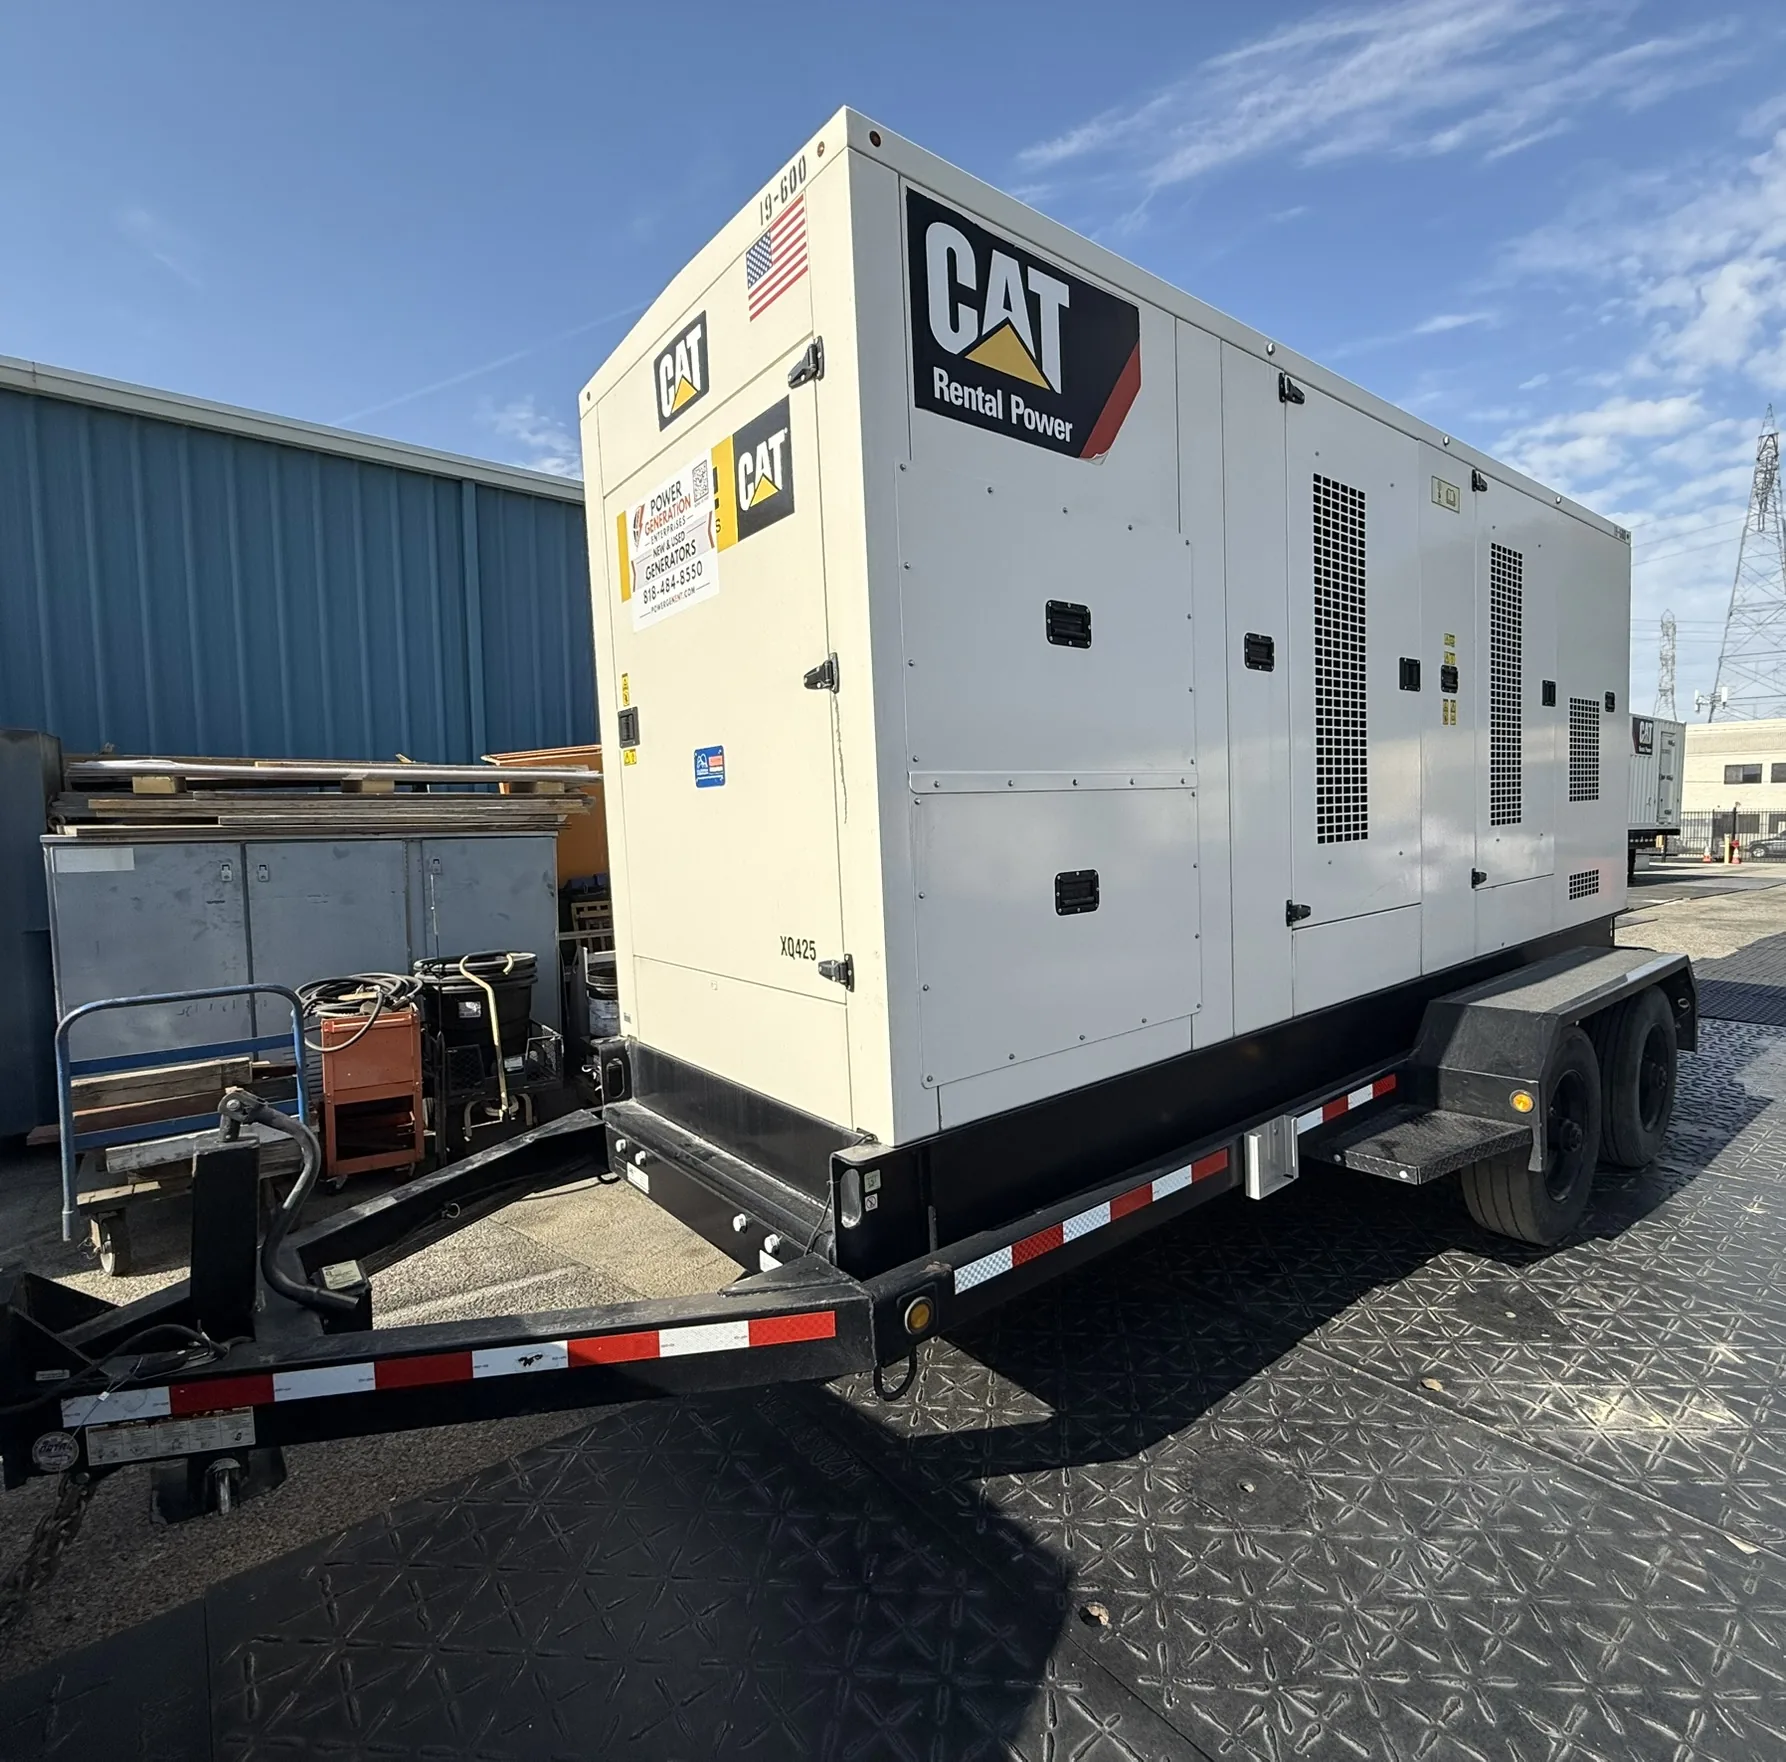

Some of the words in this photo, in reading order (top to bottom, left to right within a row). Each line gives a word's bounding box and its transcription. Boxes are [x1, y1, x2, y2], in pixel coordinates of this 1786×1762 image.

[759, 154, 807, 227] 19-600
[924, 221, 1070, 395] CAT
[659, 323, 702, 418] CAT
[933, 366, 1003, 420] Rental
[1010, 393, 1074, 443] Power
[738, 427, 788, 512] CAT
[644, 493, 691, 536] GENERATION
[650, 480, 682, 517] POWER
[650, 515, 686, 545] ENTERPRISES
[652, 542, 665, 558] NEW
[666, 539, 671, 551] &
[671, 530, 686, 547] USED
[645, 538, 697, 580] GENERATORS
[643, 560, 703, 604] 818-484-8550
[779, 935, 817, 961] XQ425
